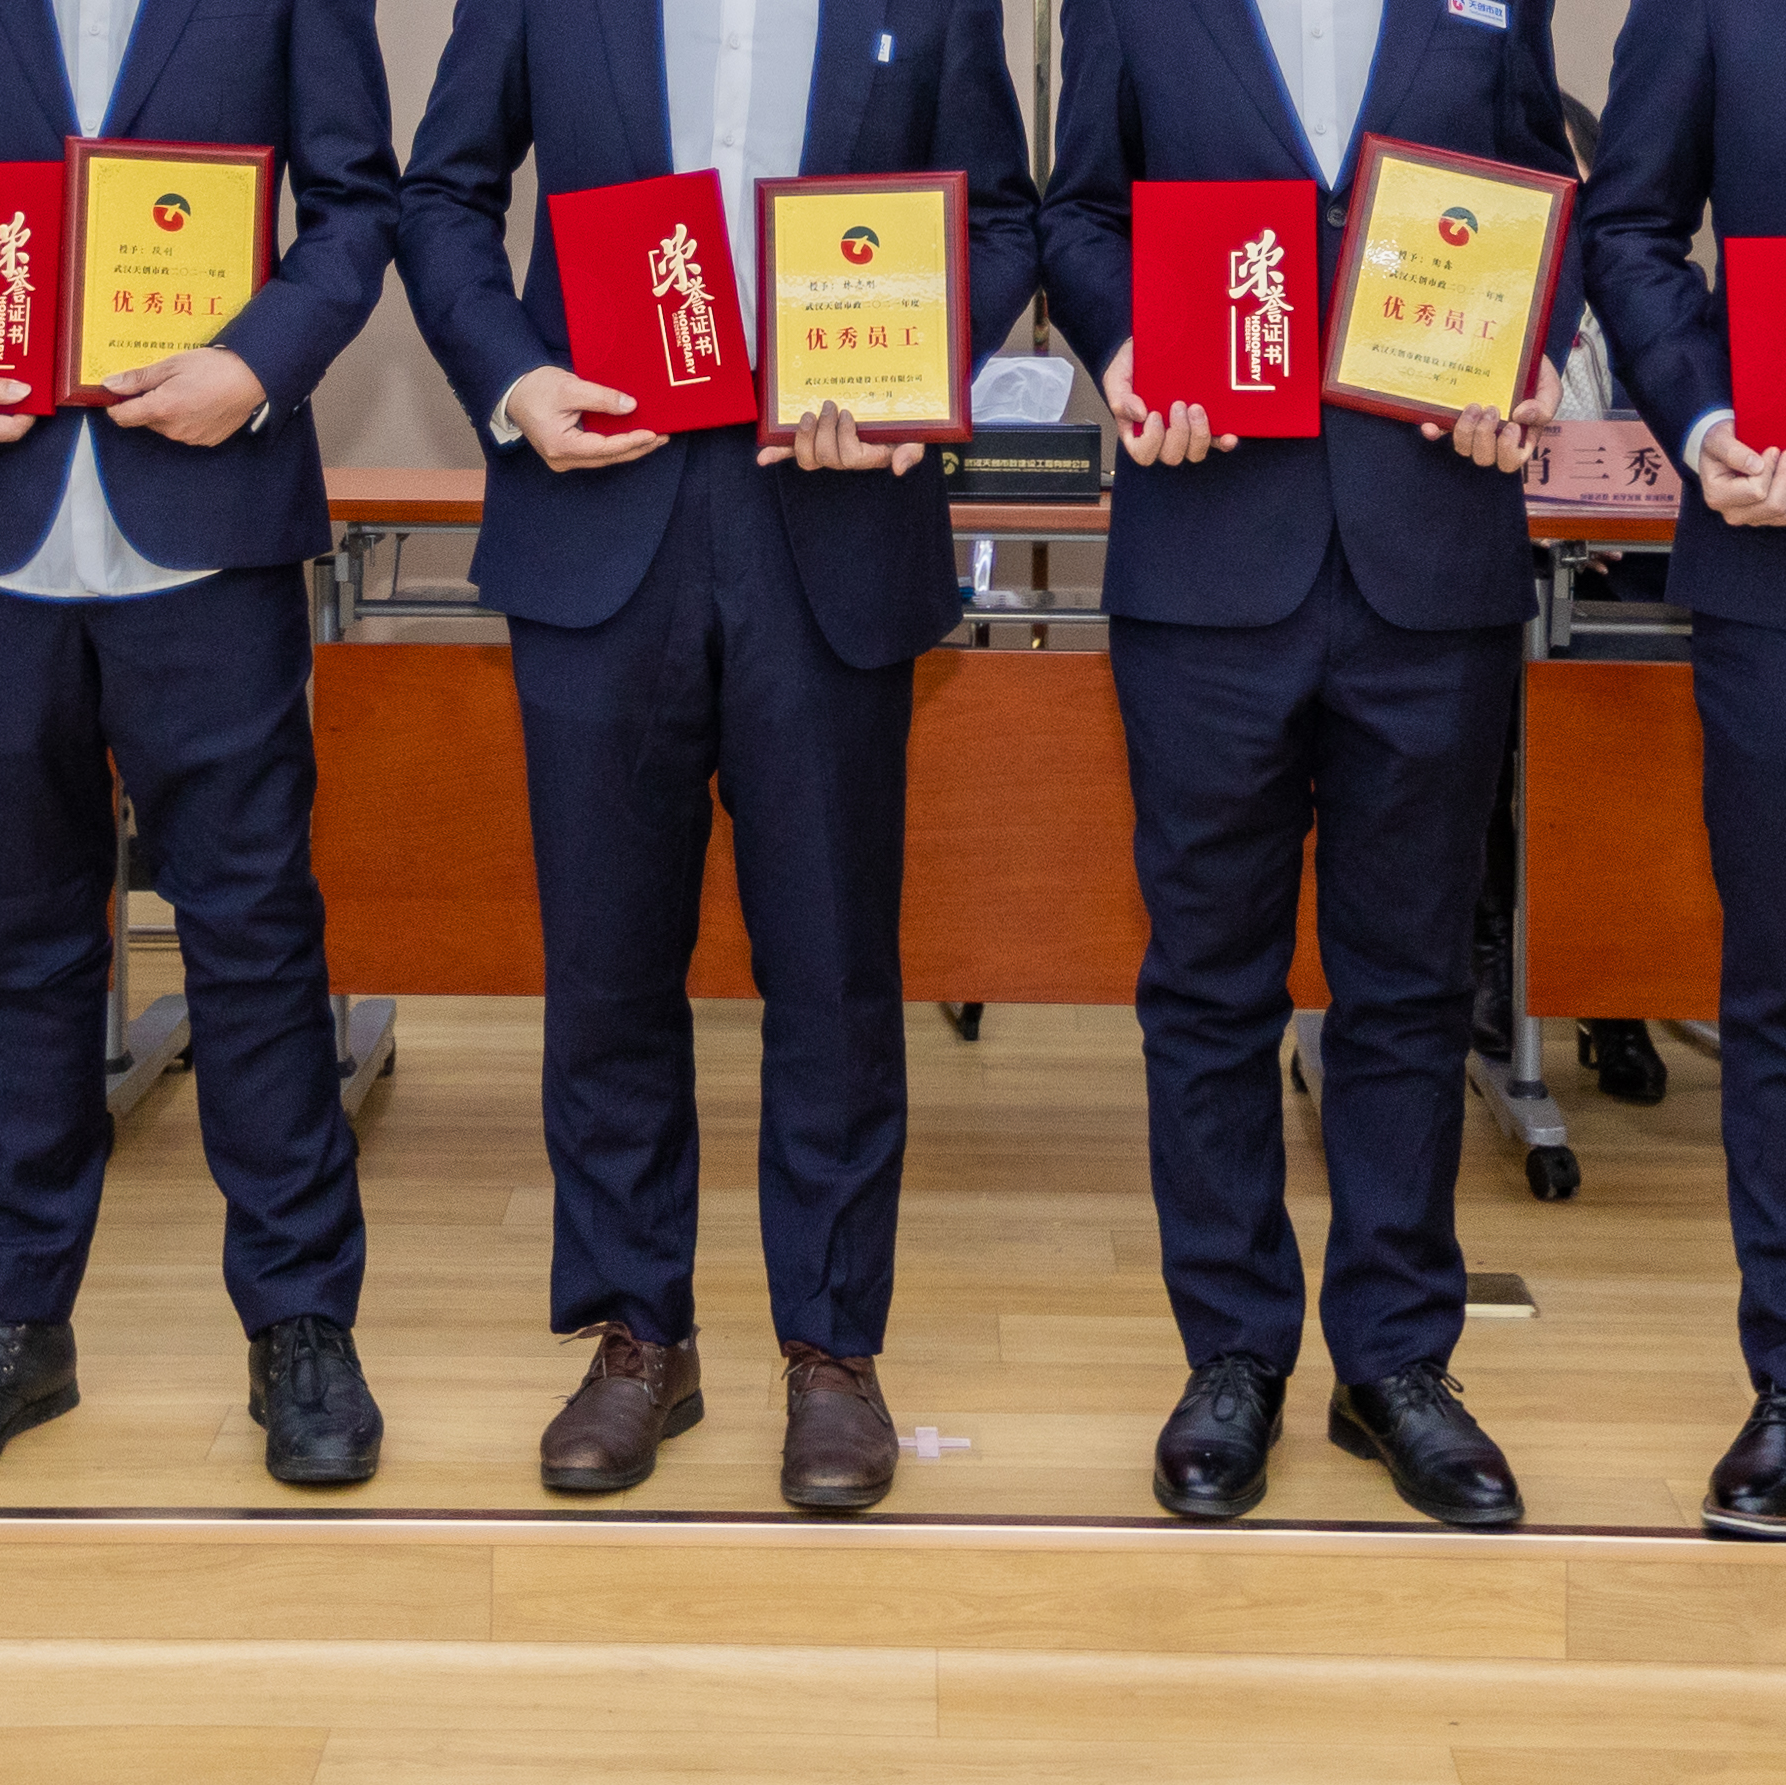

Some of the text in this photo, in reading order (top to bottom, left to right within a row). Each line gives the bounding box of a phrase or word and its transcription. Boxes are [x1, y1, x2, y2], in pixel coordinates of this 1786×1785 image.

[112, 290, 224, 316] 优秀员工
[652, 223, 716, 357] 荣誉证书
[1228, 229, 1294, 366] 荣誉证书
[1383, 295, 1498, 341] 优秀员工
[677, 310, 697, 375] HONORARY
[806, 325, 919, 351] 优秀员工
[1251, 315, 1261, 382] HONORARY
